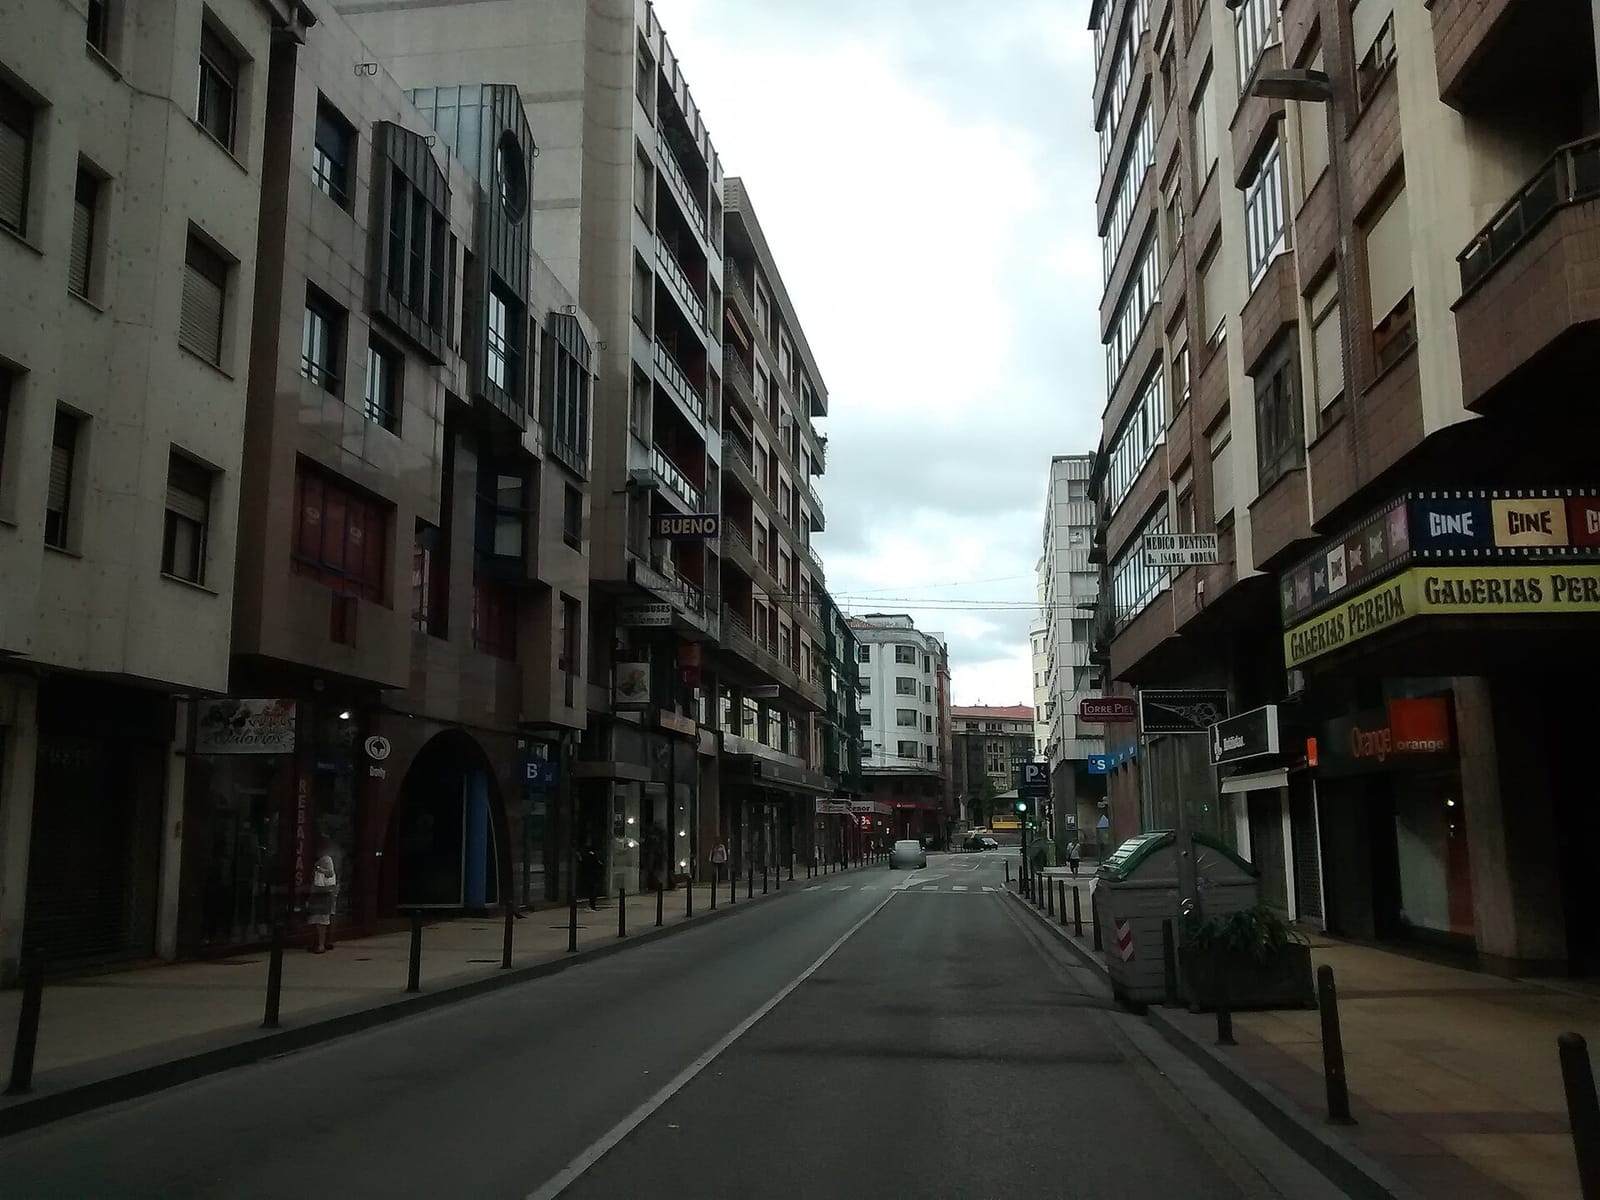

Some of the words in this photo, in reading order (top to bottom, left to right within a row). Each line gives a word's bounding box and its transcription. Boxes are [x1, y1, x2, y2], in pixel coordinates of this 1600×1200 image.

[661, 518, 716, 534] BUENO
[1429, 511, 1474, 537] CINE
[1507, 510, 1553, 535] CINE
[1179, 535, 1217, 549] DENTISTA
[1160, 552, 1186, 563] ISABEL
[1425, 577, 1543, 605] GALERIAS
[1290, 613, 1345, 662] GALERIAS
[1347, 584, 1406, 635] PEREDA
[1082, 702, 1113, 714] TORRE
[1115, 703, 1134, 713] PIEL
[1352, 728, 1391, 762] Orange
[1397, 740, 1445, 753] orange
[1025, 765, 1039, 782] P
[296, 779, 307, 887] REBAJAS
